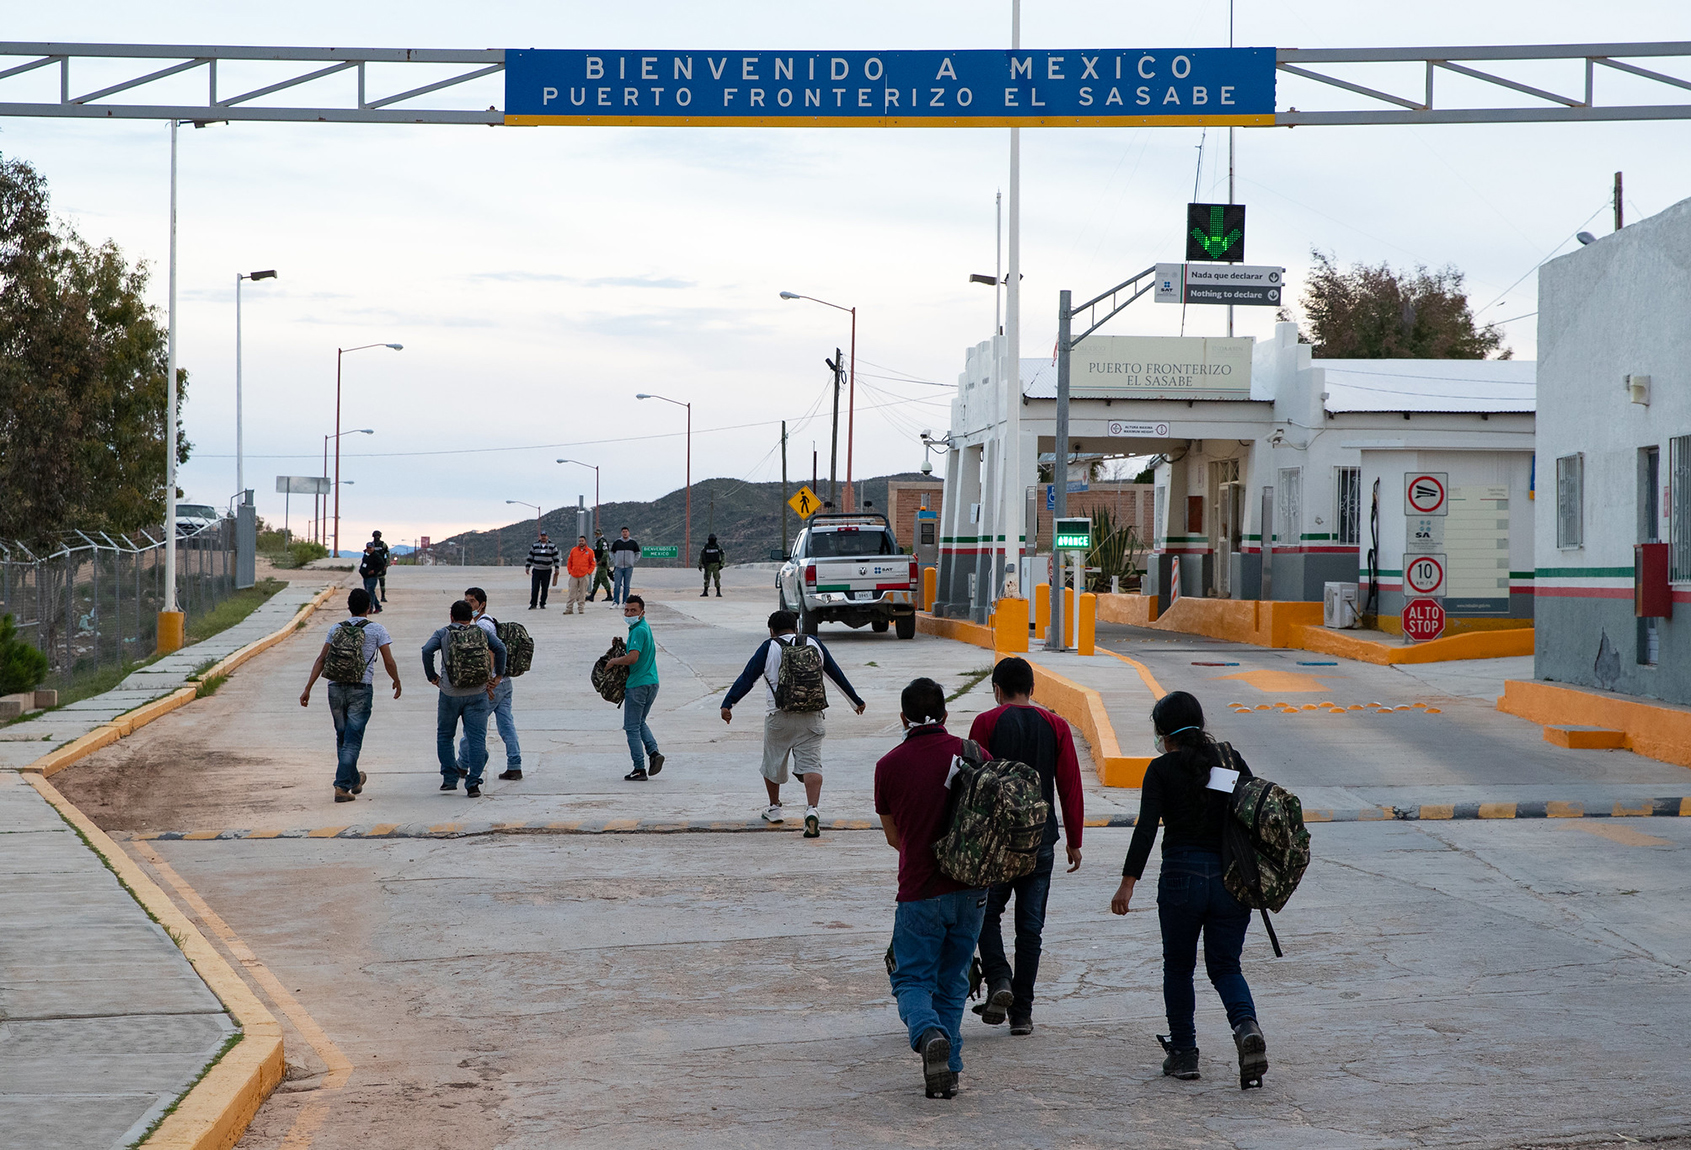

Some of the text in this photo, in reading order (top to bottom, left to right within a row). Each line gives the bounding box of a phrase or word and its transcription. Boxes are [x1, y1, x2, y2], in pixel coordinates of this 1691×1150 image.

[586, 55, 1192, 81] BIENVENIDO A MEXICO
[543, 86, 1236, 108] PUERTO FRONTERIZO EL SASABE
[1191, 271, 1212, 279] Nada
[1230, 272, 1264, 280] declarar
[1190, 289, 1222, 299] Nothing
[1233, 290, 1263, 299] declare
[1089, 362, 1232, 376] PUERTO FRONTERIZO
[1127, 375, 1193, 387] EL SASABE
[1057, 536, 1088, 546] AVANCE
[1417, 563, 1433, 579] 10
[1408, 606, 1439, 620] ALTO
[1408, 620, 1439, 634] STOP
